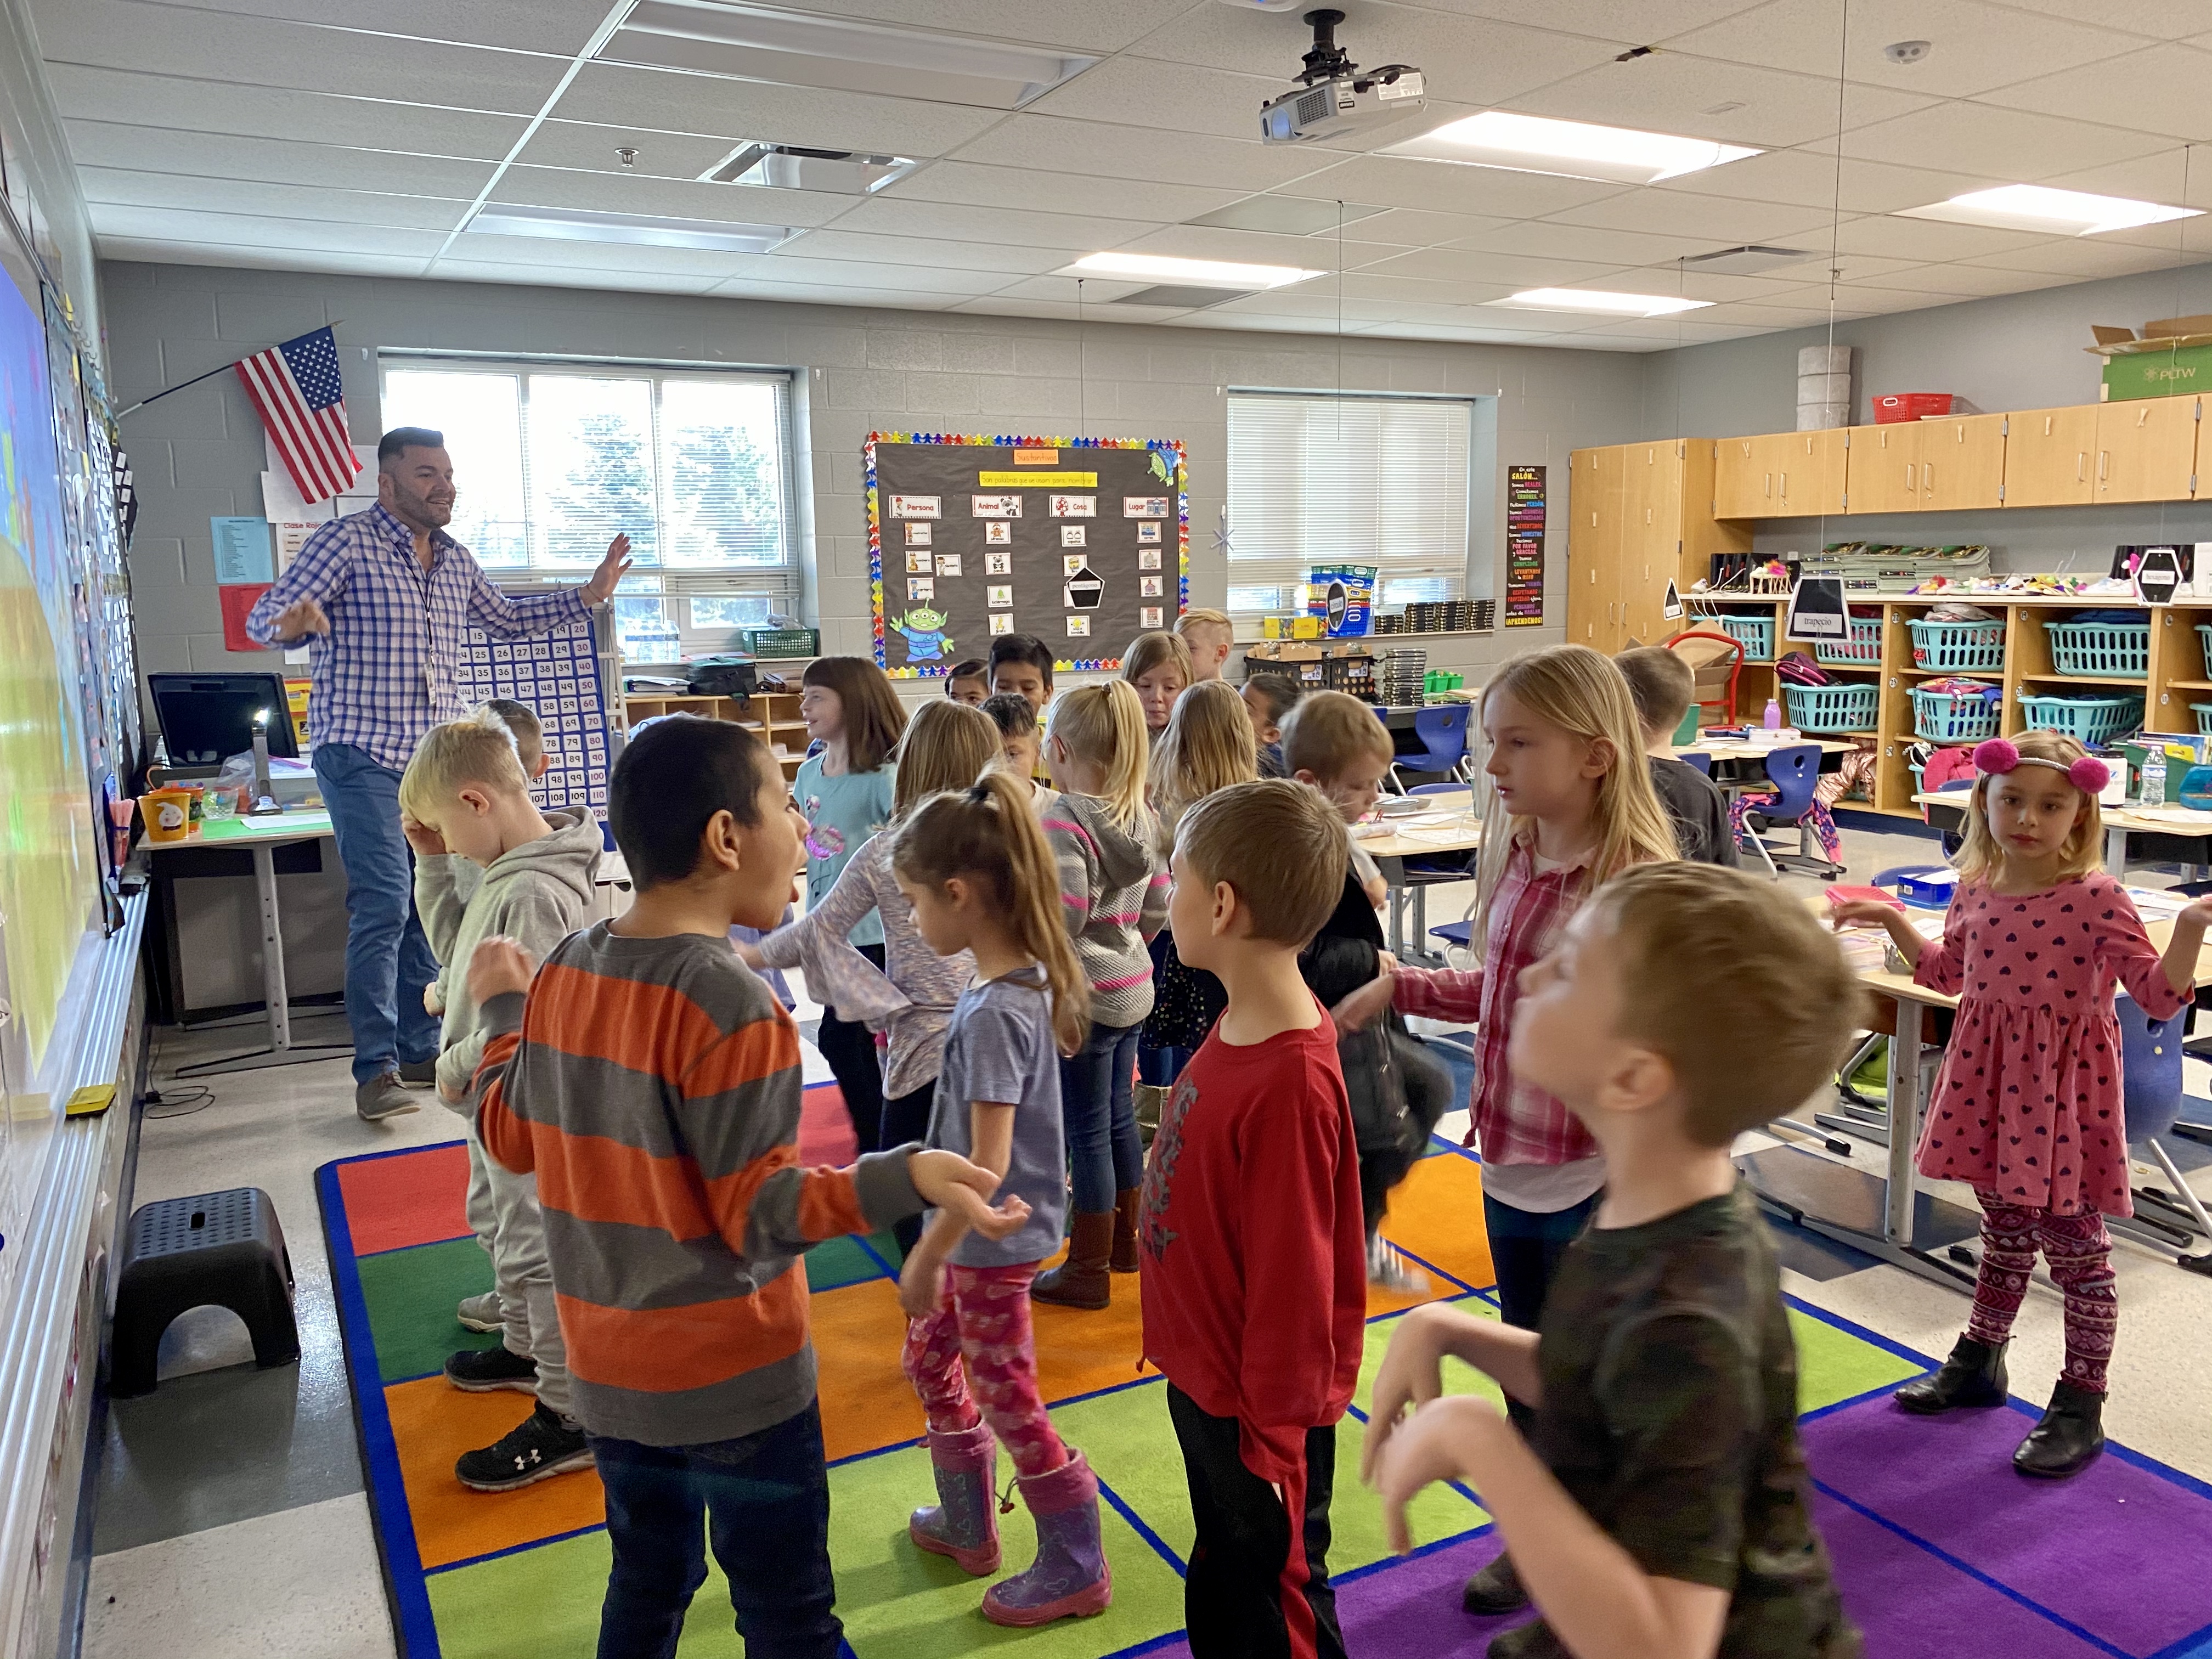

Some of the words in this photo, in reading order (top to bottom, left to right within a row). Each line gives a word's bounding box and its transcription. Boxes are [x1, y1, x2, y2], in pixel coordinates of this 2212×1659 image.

[2160, 367, 2196, 380] PLTW
[1016, 453, 1057, 461] Sustantivos
[995, 476, 1017, 484] palabras
[1804, 617, 1831, 627] trapecio
[558, 663, 569, 672] 39
[582, 681, 593, 689] 50
[563, 701, 574, 709] 59
